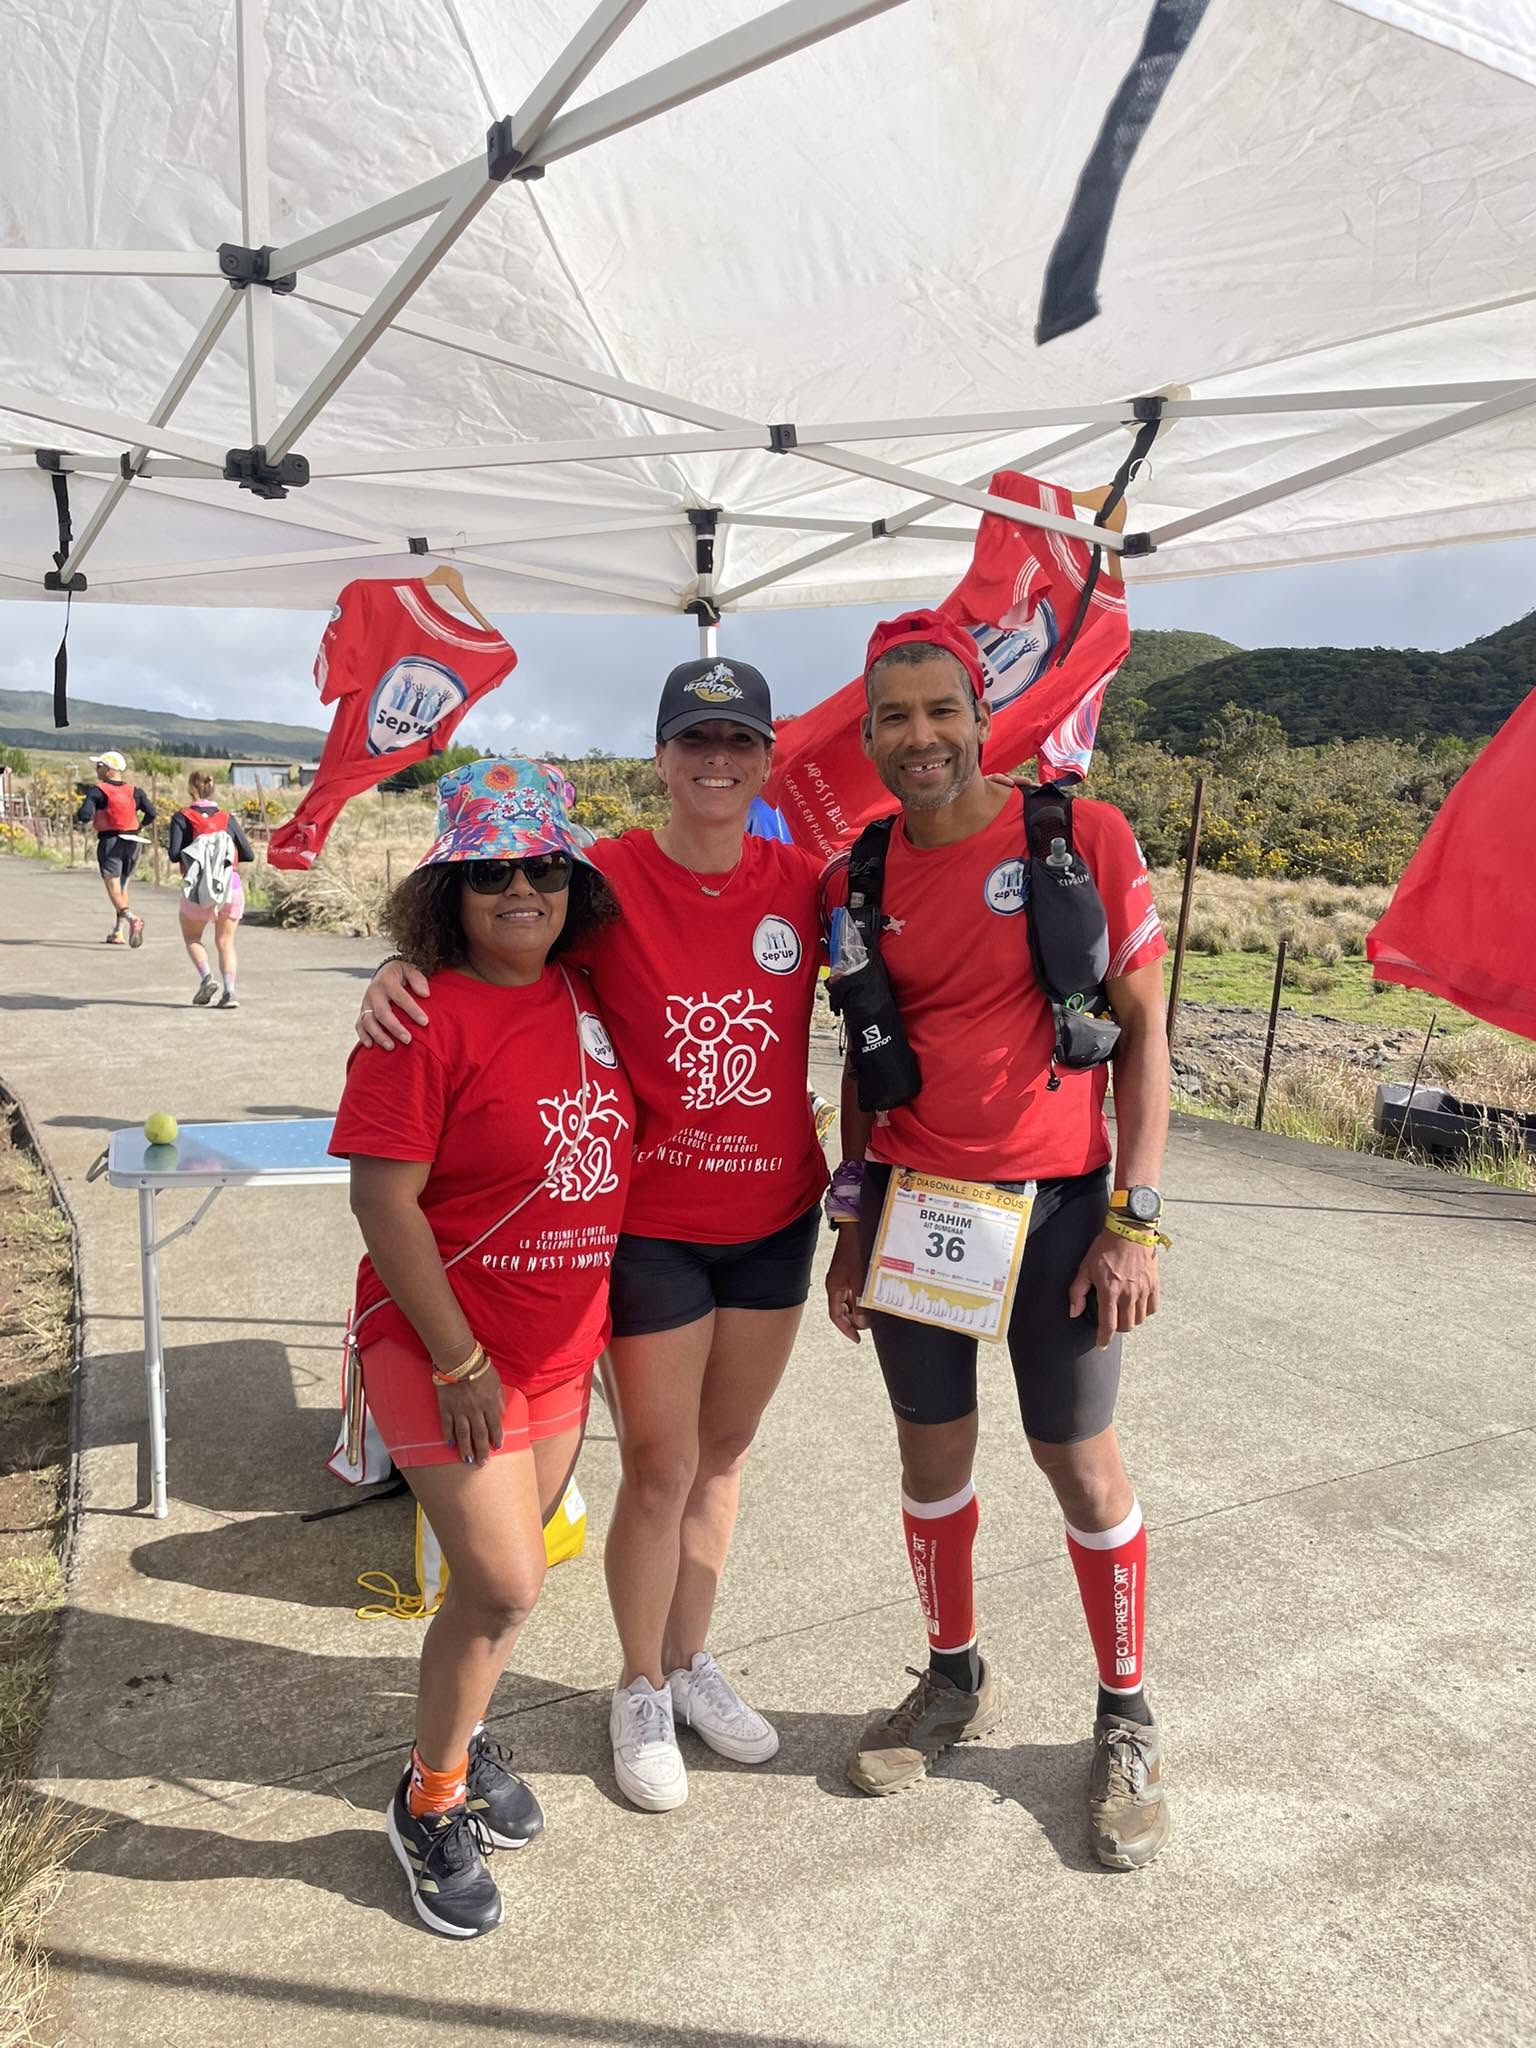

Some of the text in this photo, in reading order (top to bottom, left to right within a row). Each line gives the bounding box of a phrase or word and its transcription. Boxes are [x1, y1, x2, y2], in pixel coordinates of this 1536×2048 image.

[762, 950, 794, 961] Sep'UP
[656, 1146, 692, 1168] N'EST
[698, 1157, 783, 1173] IMPOSSIBLE!
[916, 1178, 1025, 1209] DIAGONALE DES FOUS
[920, 1209, 973, 1229] BRAHIM
[925, 1231, 966, 1262] 36
[1114, 1564, 1130, 1657] COMPRESSPORT
